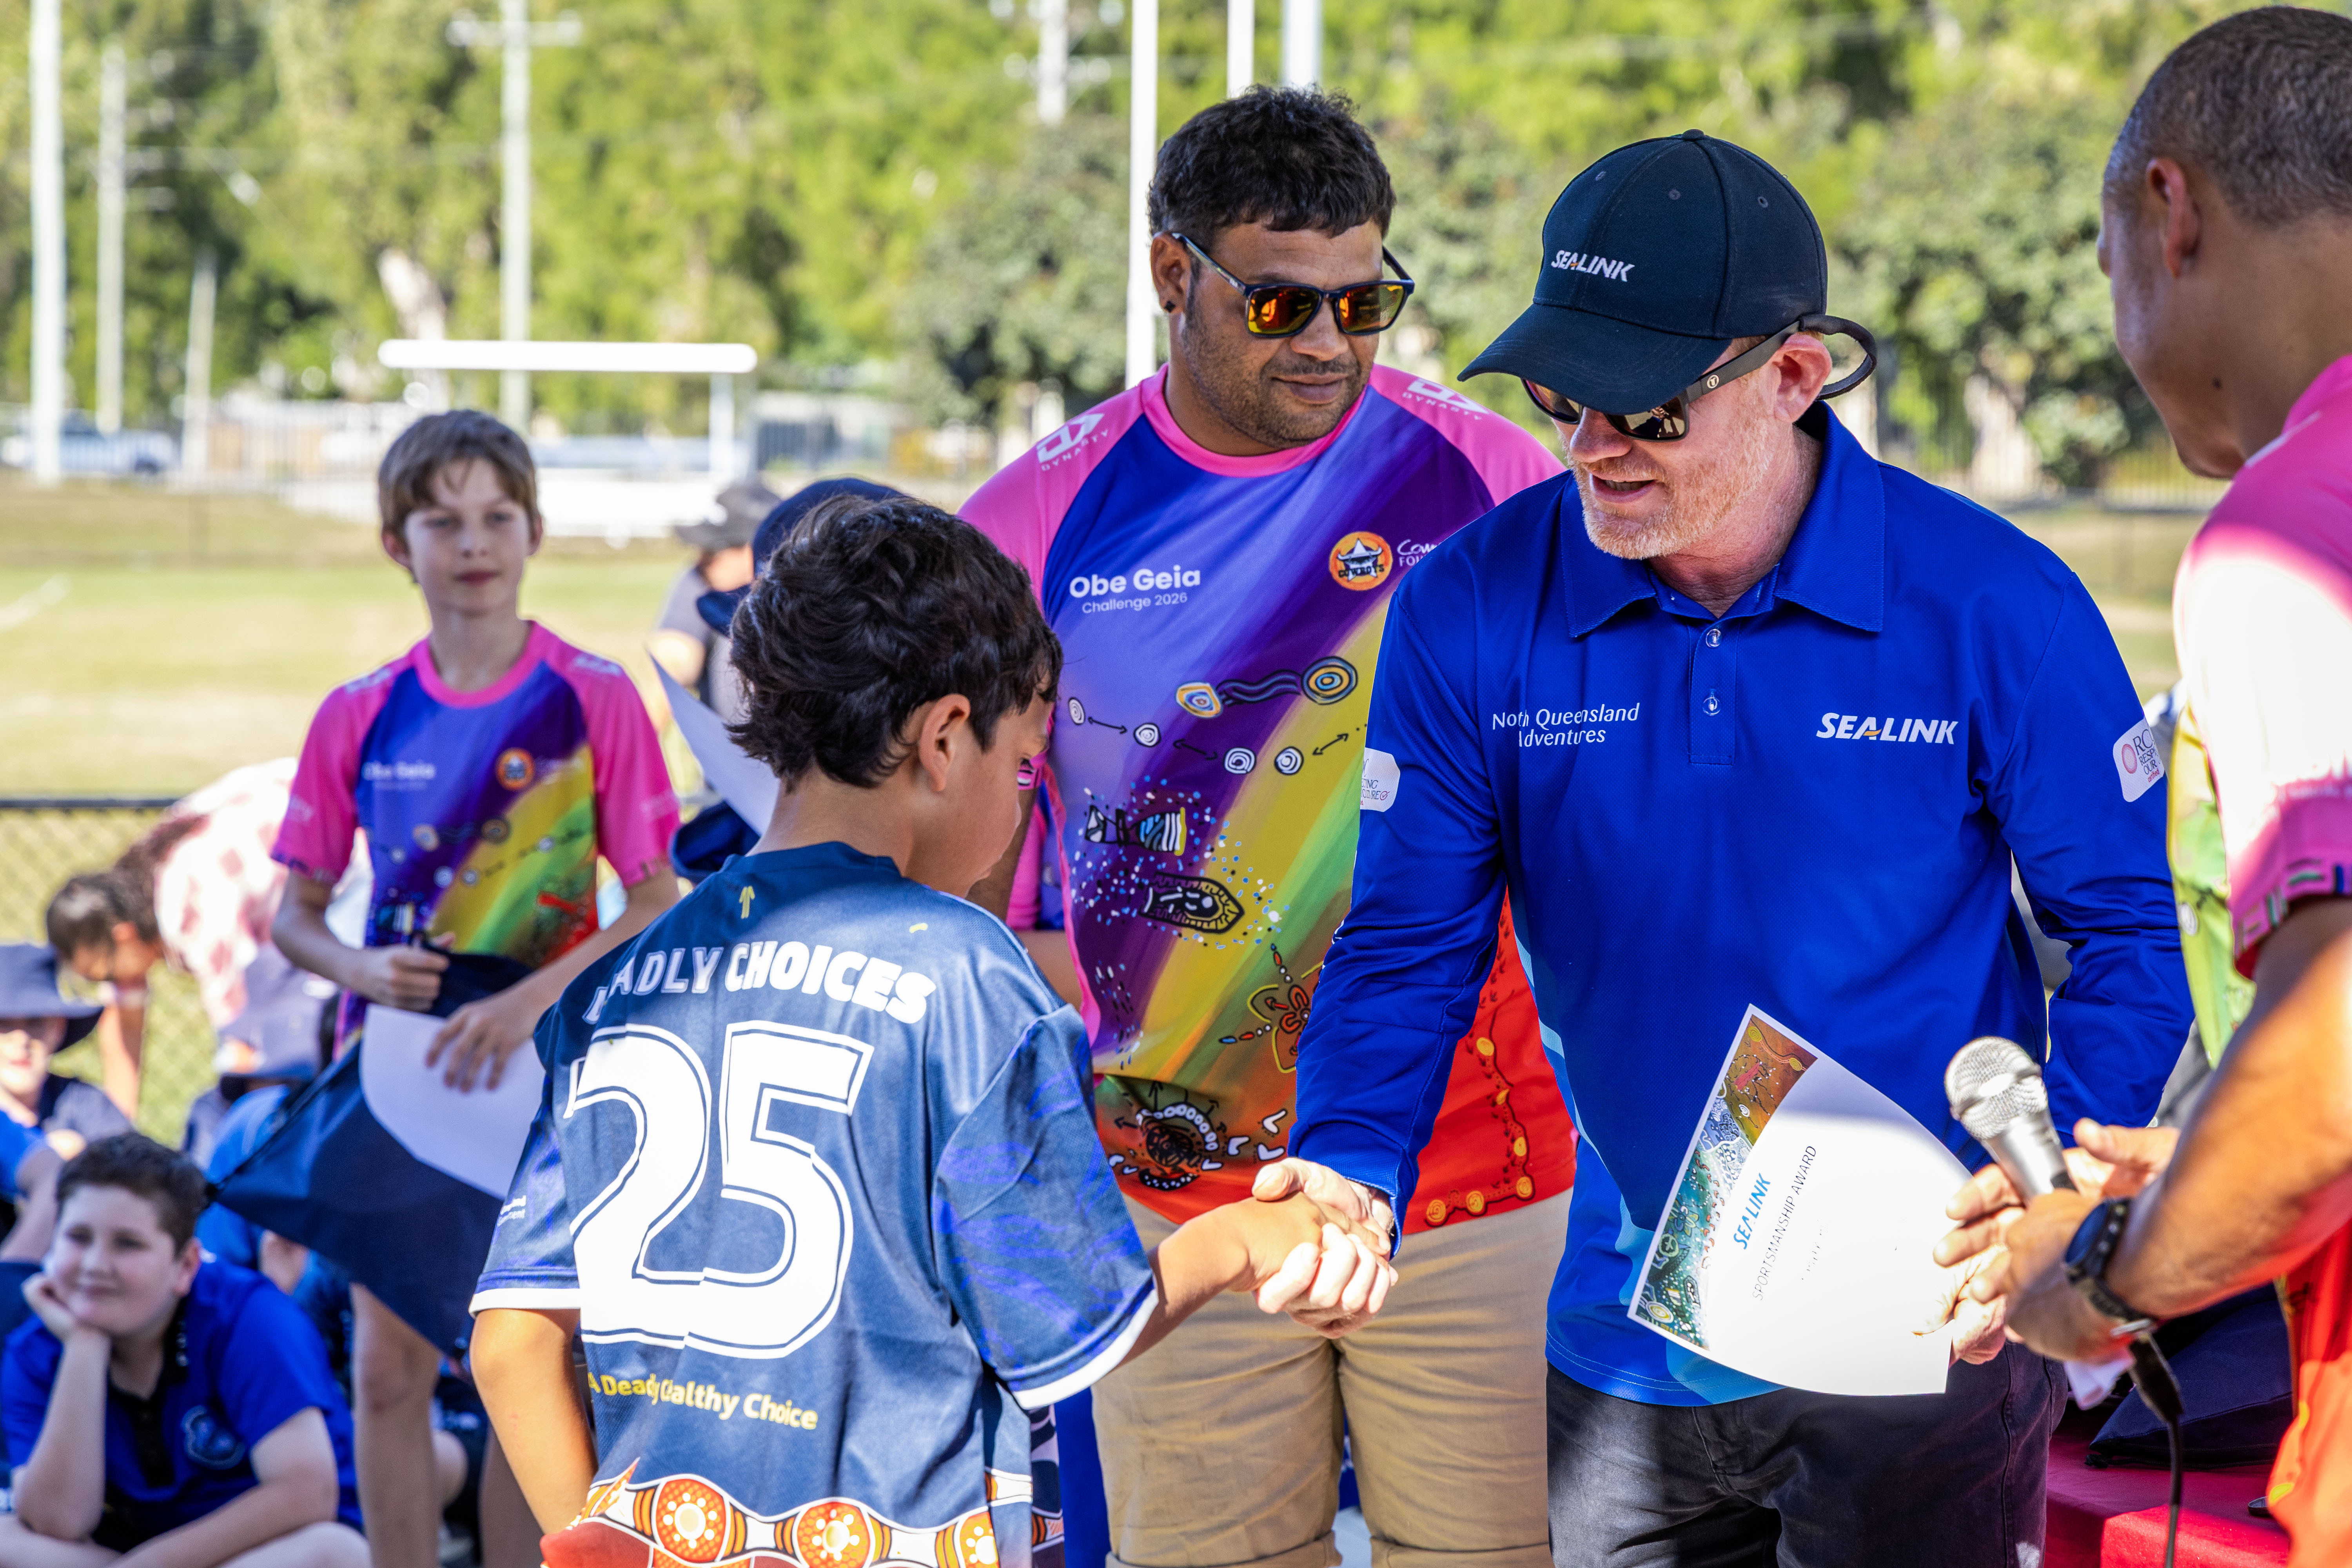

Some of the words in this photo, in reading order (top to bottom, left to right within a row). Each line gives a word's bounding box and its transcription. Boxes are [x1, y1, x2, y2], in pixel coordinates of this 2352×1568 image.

[1551, 250, 1635, 282] SEALINK
[1069, 574, 1127, 598] Obe
[1133, 564, 1201, 591] Geia
[1082, 597, 1151, 614] Challenge
[1154, 592, 1188, 606] 2026
[1535, 702, 1640, 730] Queensland
[1816, 712, 1959, 744] SEALINK
[2143, 759, 2158, 775] OUR
[725, 941, 937, 1024] CHOICES
[563, 1020, 875, 1359] 25
[1733, 1172, 1771, 1250] SEALINK
[1753, 1196, 1795, 1301] SPORTSMANSHIP
[1791, 1146, 1817, 1195] AWARD
[743, 1393, 818, 1430] Choice
